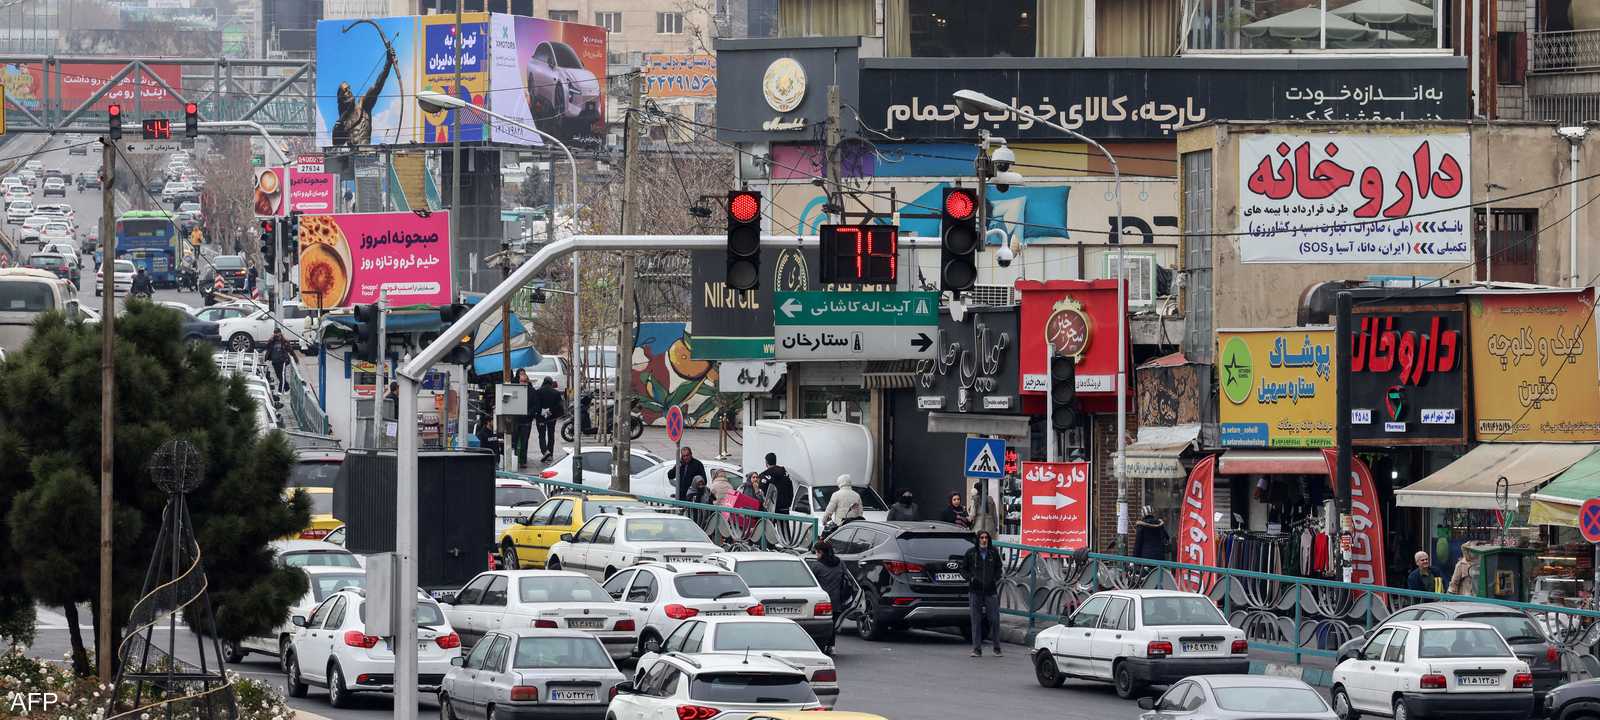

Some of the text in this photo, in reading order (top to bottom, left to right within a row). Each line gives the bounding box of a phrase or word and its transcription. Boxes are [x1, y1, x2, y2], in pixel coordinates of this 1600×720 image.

[429, 52, 453, 70] دلیران
[1285, 85, 1443, 105] به اندازه خودت
[886, 97, 961, 130] حمام
[985, 97, 1057, 130] خواب
[1060, 96, 1128, 130] کالای
[1248, 140, 1463, 218] داروخانه
[1244, 204, 1348, 217] طرف قرارداد با بیمه های
[1437, 221, 1463, 233] بانک
[360, 230, 439, 249] صبحونه امروز
[1336, 241, 1355, 255] آسیا
[1437, 241, 1467, 255] تکمیلی
[360, 253, 440, 270] حلیم گرم و تازه روز
[836, 227, 897, 280] 74
[810, 300, 911, 317] آیت اله کاشانی
[782, 333, 849, 352] ستارخان
[1352, 316, 1458, 386] داروخان
[1488, 325, 1585, 371] کیک و کلوچه
[1269, 334, 1331, 382] پوشاک
[1257, 375, 1316, 404] ستاره سهیل
[1518, 376, 1558, 410] متین
[1026, 466, 1086, 488] داروخانه
